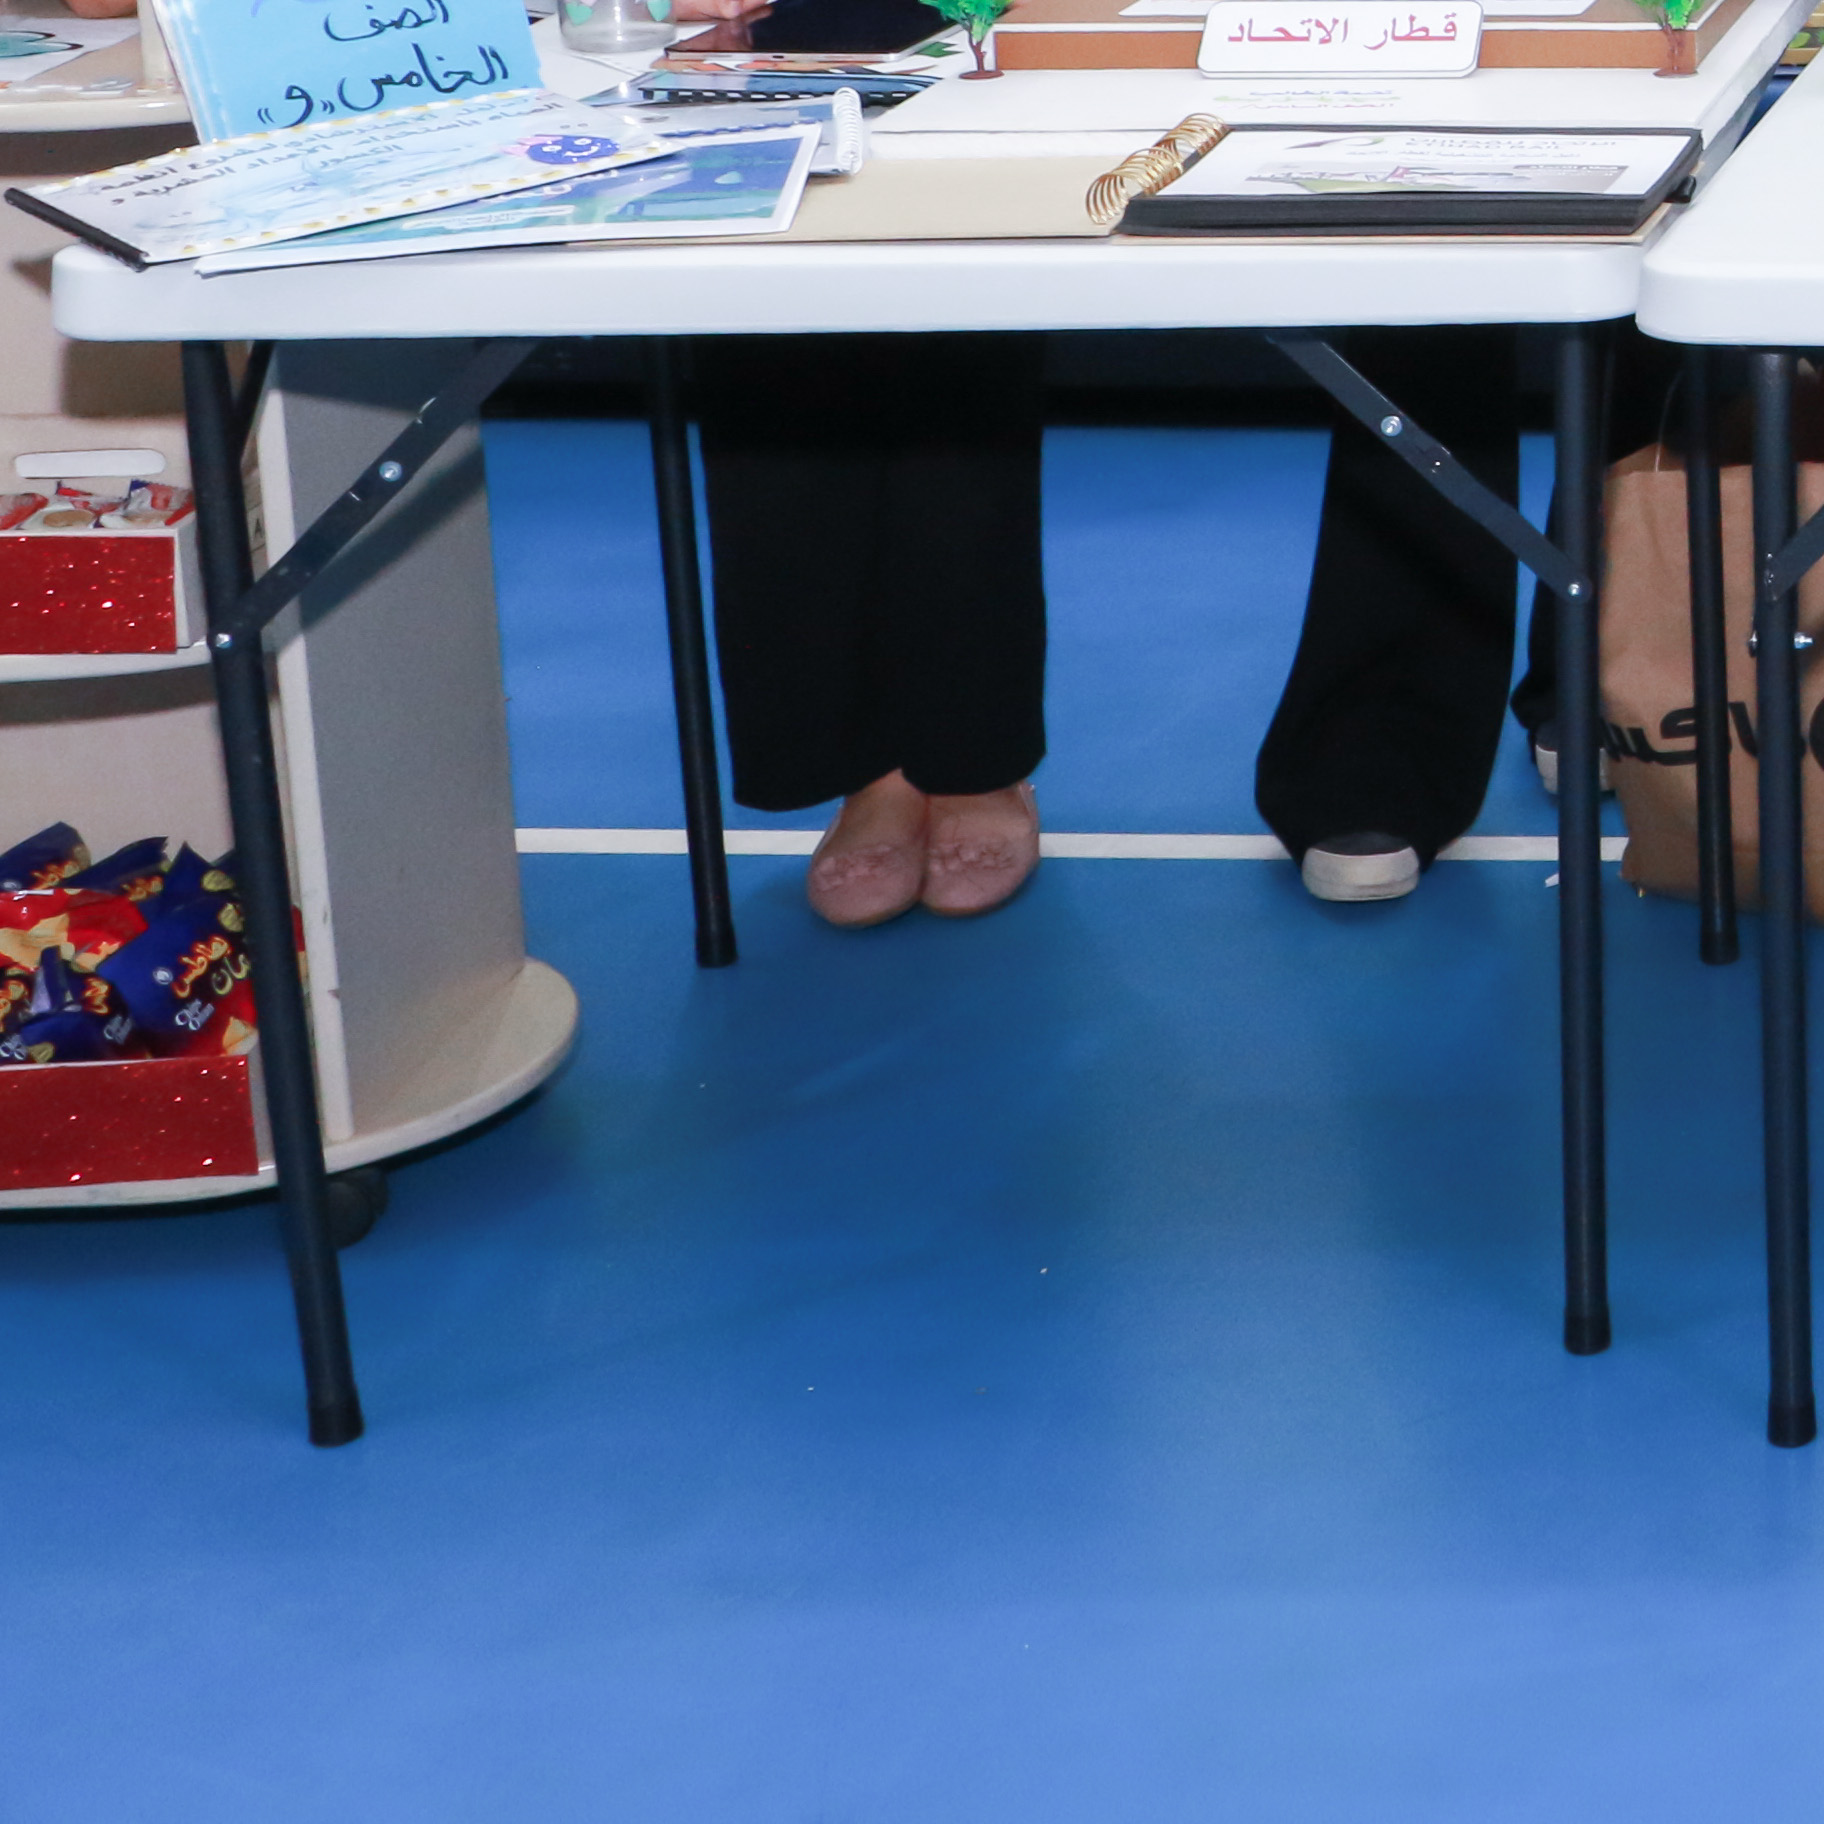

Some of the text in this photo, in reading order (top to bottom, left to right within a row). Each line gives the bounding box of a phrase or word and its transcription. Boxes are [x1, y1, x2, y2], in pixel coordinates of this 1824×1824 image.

[1226, 11, 1458, 52] قطار الاتحاد
[336, 43, 509, 115] الخامس
